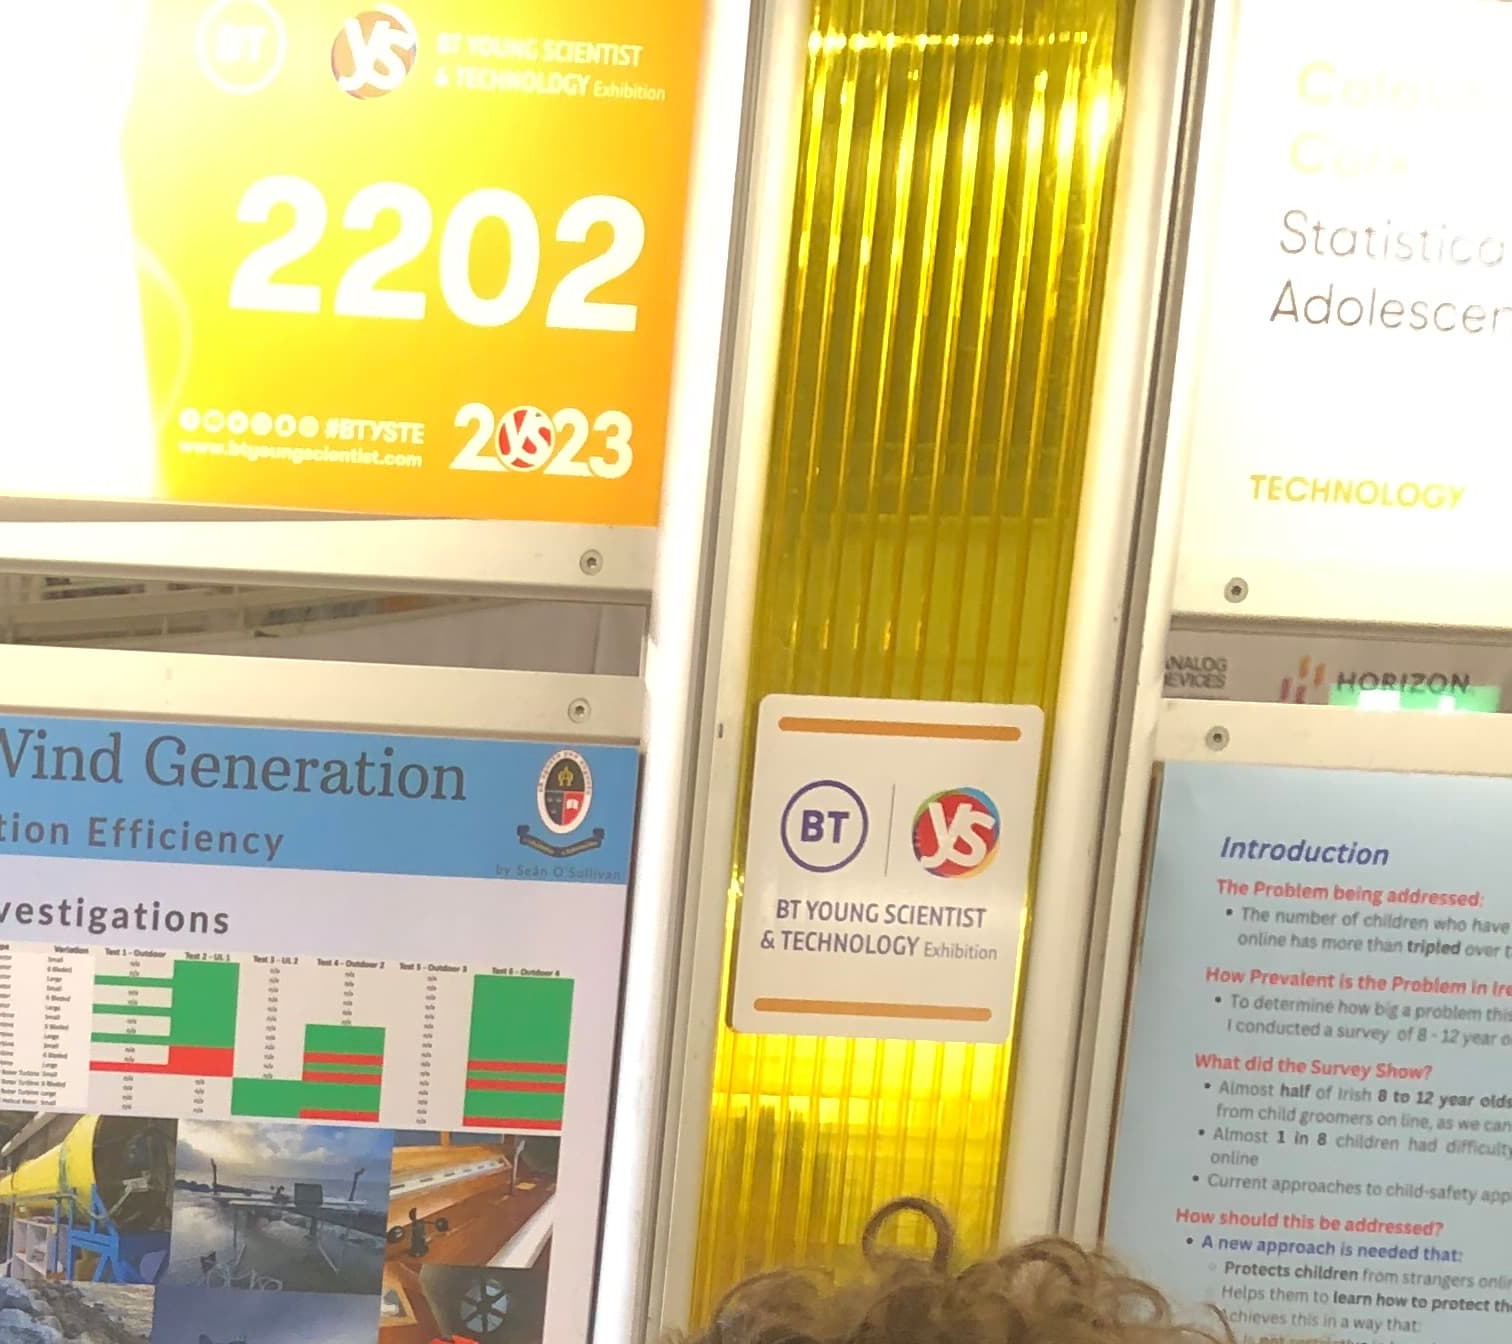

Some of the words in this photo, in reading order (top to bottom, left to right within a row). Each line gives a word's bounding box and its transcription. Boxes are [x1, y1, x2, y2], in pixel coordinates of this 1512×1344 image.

[436, 33, 462, 57] BT
[468, 34, 537, 61] YOUNG
[544, 39, 643, 67] SCIENTIST
[434, 66, 449, 87] &
[456, 66, 588, 97] TECHNOLOGY
[594, 80, 665, 102] Exhibition
[229, 175, 645, 332] 2202
[324, 415, 425, 446] #BTYSTE
[1249, 473, 1466, 510] TECHNOLOGY
[1338, 671, 1470, 694] HORIZON
[144, 734, 467, 801] Generation
[88, 815, 286, 861] Efficiency
[801, 809, 849, 844] BT
[1220, 836, 1390, 867] Introduction
[1217, 878, 1249, 896] The
[1254, 880, 1328, 901] Problem
[1334, 884, 1383, 906] being
[776, 898, 803, 920] BT
[805, 899, 879, 923] YOUNG
[883, 903, 987, 928] SCIENTIST
[1242, 906, 1270, 923] The
[1275, 909, 1336, 926] number
[1342, 912, 1359, 928] of
[1363, 912, 1428, 931] children
[1434, 917, 1467, 933] who
[1472, 917, 1510, 935] have
[760, 930, 775, 950] &
[781, 931, 919, 957] TECHNOLOGY
[924, 941, 997, 961] Exhibition
[1205, 966, 1245, 984] How
[1249, 968, 1334, 989] Prevalent
[1339, 972, 1353, 989] is
[1358, 974, 1387, 992] the
[1392, 976, 1467, 996] Problem
[1472, 980, 1488, 997] in
[1195, 1054, 1240, 1071] What
[1245, 1054, 1273, 1073] did
[1278, 1057, 1307, 1074] the
[1311, 1059, 1370, 1081] Survey
[1375, 1063, 1433, 1081] Show?
[1175, 1208, 1215, 1226] How
[1219, 1210, 1279, 1229] should
[1283, 1213, 1314, 1231] this
[1319, 1215, 1341, 1232] be
[1345, 1217, 1444, 1237] addressed?
[1202, 1236, 1213, 1250] A
[1218, 1239, 1253, 1253] new
[1257, 1239, 1336, 1257] approach
[1340, 1242, 1354, 1257] is
[1357, 1243, 1419, 1262] needed
